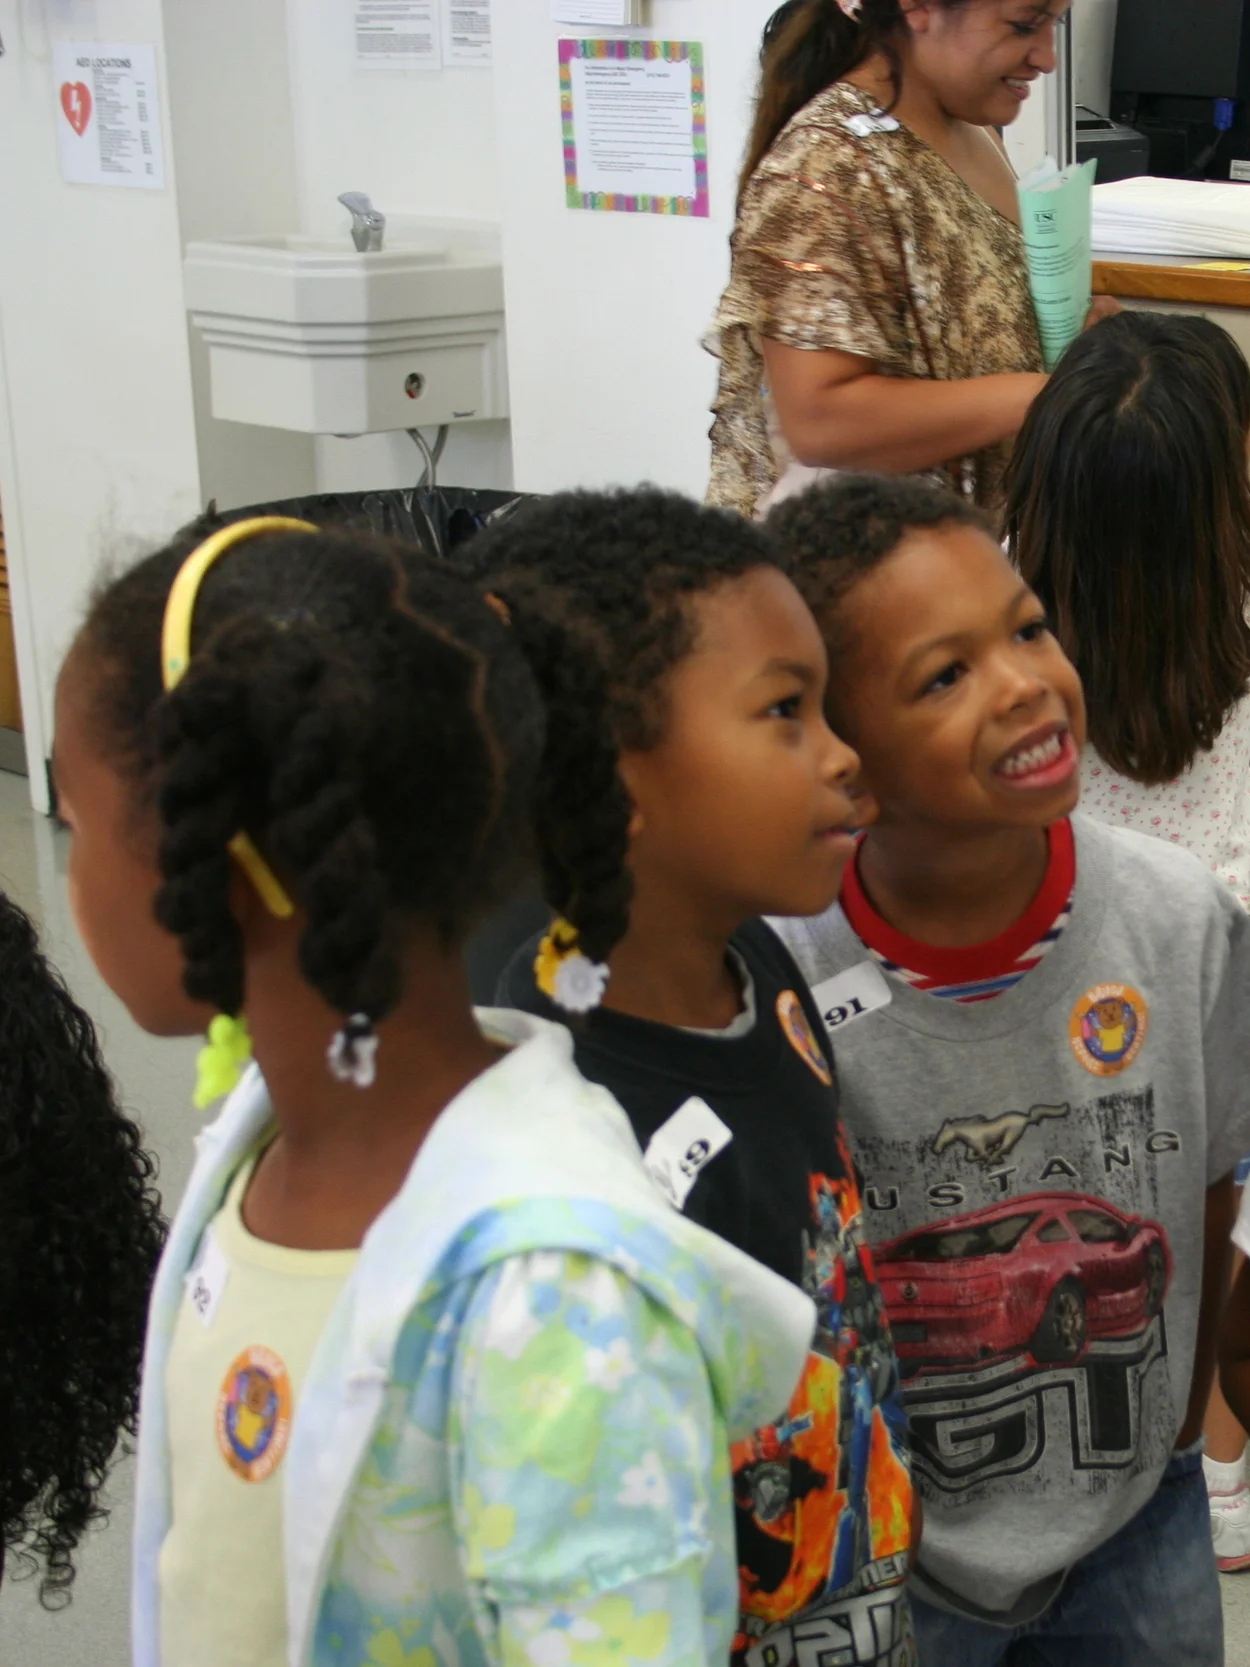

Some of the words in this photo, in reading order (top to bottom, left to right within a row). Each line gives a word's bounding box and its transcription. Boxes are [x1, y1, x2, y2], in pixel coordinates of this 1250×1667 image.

[92, 57, 132, 69] LOCATIONS
[824, 996, 867, 1027] 91
[865, 1130, 1181, 1211] USTANG
